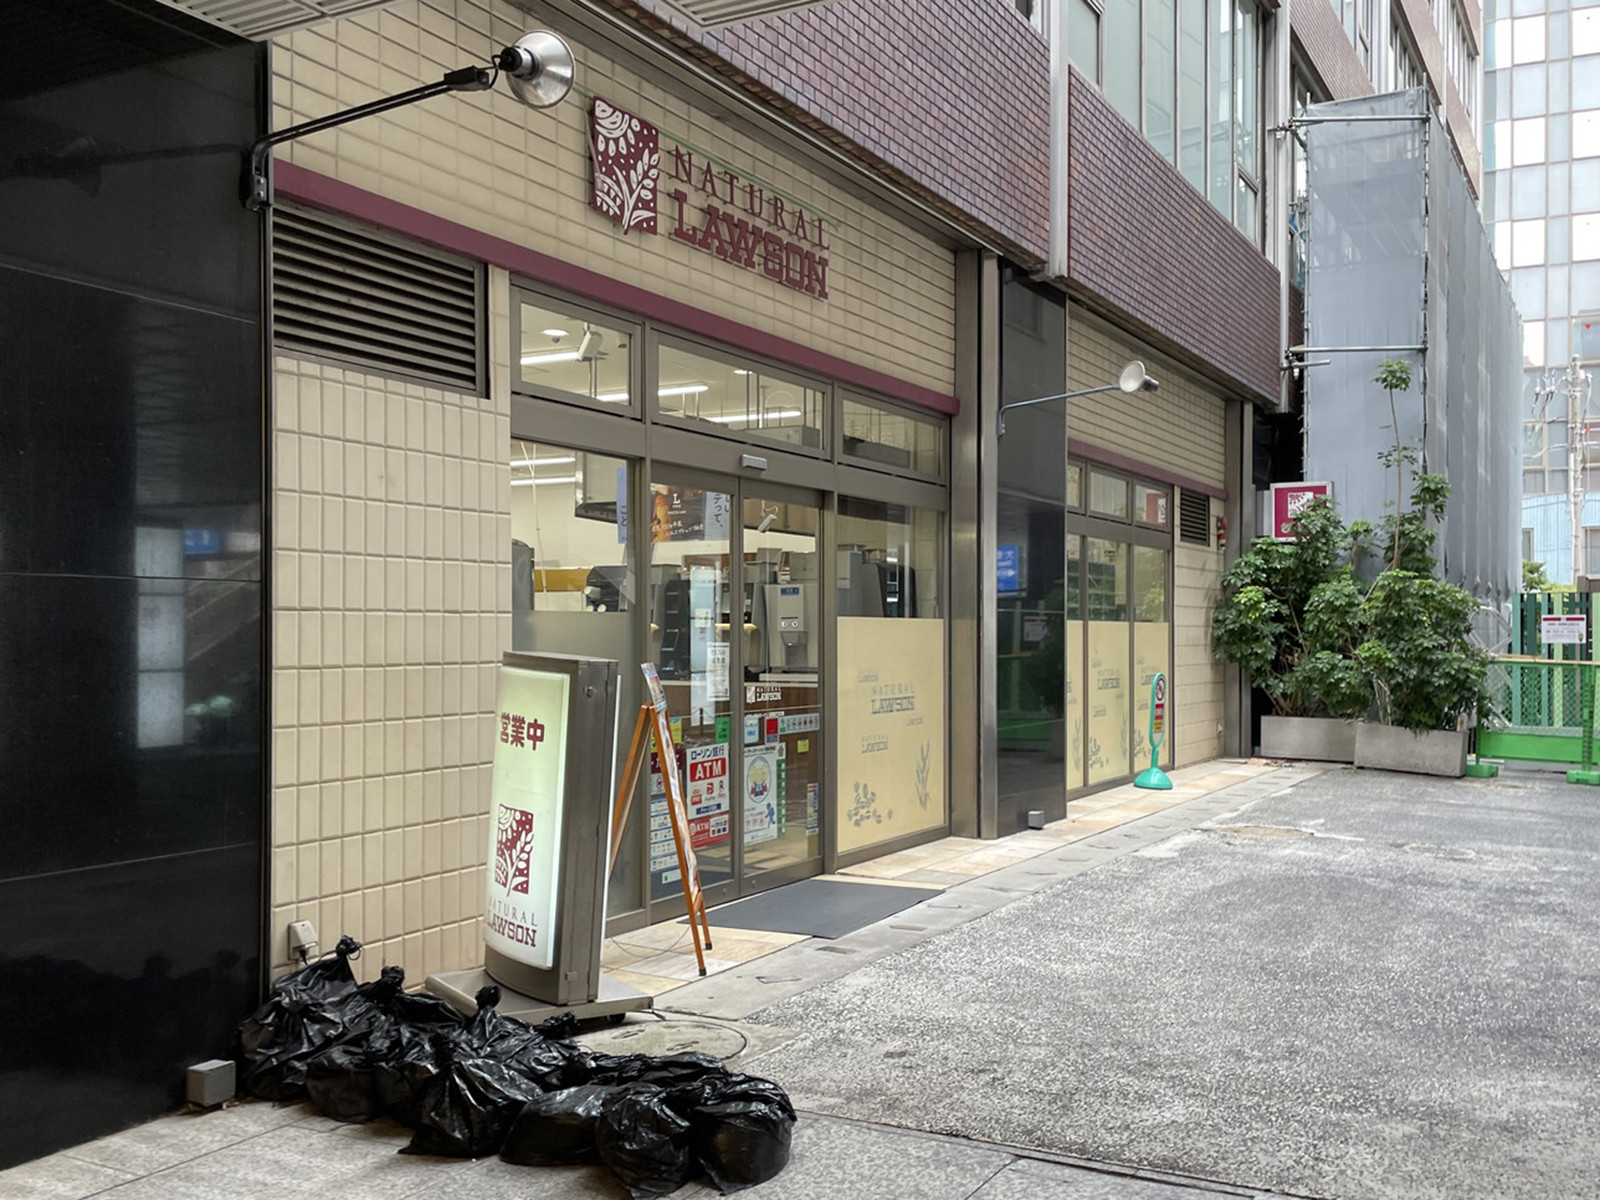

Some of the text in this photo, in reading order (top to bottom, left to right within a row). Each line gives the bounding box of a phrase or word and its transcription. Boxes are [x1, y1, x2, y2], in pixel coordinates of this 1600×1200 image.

[674, 144, 830, 250] NATURAL
[673, 188, 829, 300] LAWSON
[871, 695, 916, 715] LAWSON
[500, 711, 545, 751] 営業中
[694, 760, 722, 780] ATM
